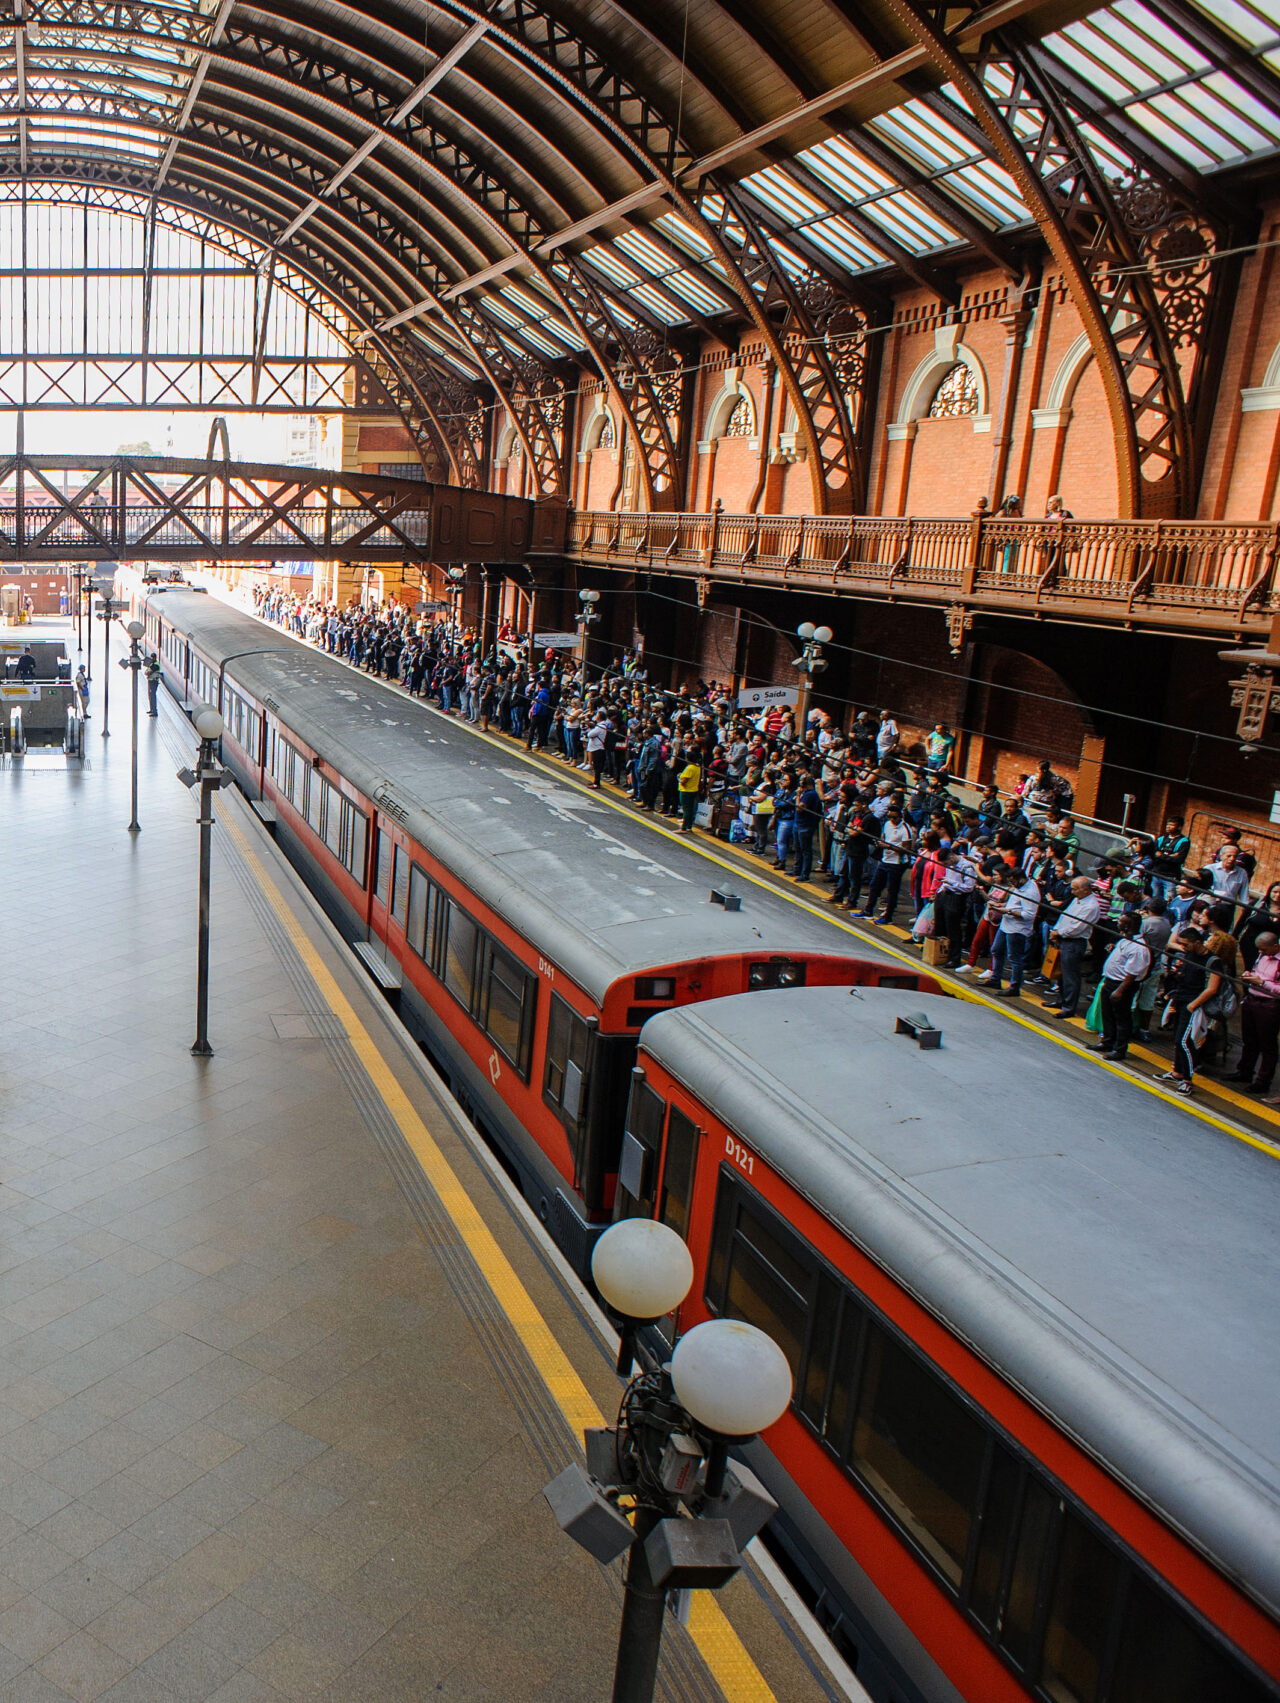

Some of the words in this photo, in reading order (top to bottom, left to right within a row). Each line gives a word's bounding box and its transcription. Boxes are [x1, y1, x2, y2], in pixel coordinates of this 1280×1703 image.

[764, 690, 787, 698] Saída
[538, 956, 554, 981] D141
[725, 1135, 753, 1175] D121
